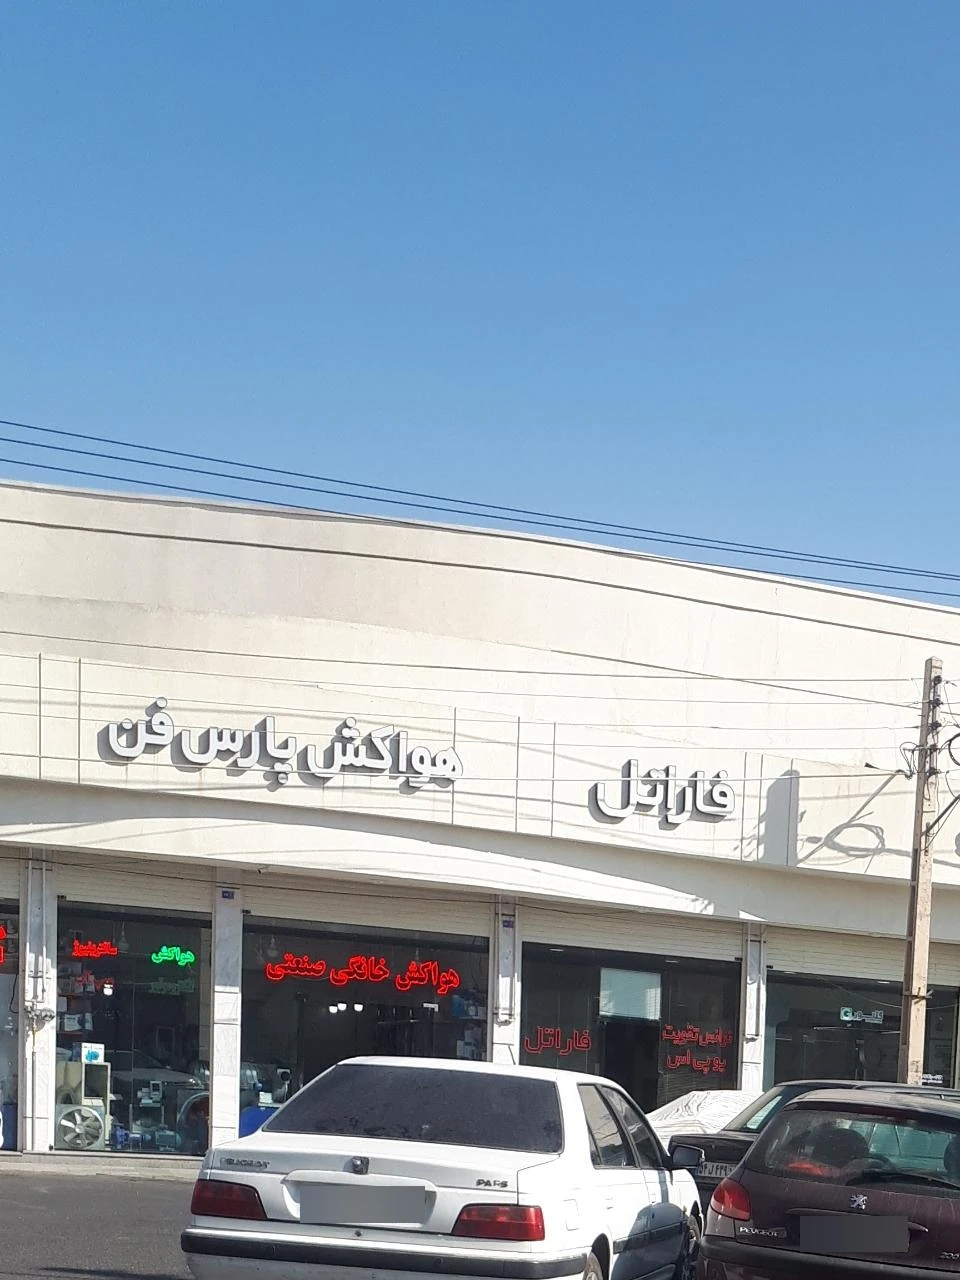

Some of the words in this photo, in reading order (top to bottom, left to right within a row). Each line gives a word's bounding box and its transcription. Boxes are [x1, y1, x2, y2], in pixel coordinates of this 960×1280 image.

[108, 697, 174, 758] فن
[181, 715, 297, 785] پارس
[307, 717, 463, 788] هواکش
[596, 758, 736, 824] فاراتل
[151, 945, 195, 966] هواکش
[265, 953, 327, 981] صنعتی
[329, 955, 390, 986] خانگی
[395, 960, 461, 995] هواکش
[524, 1026, 592, 1055] فاراتل
